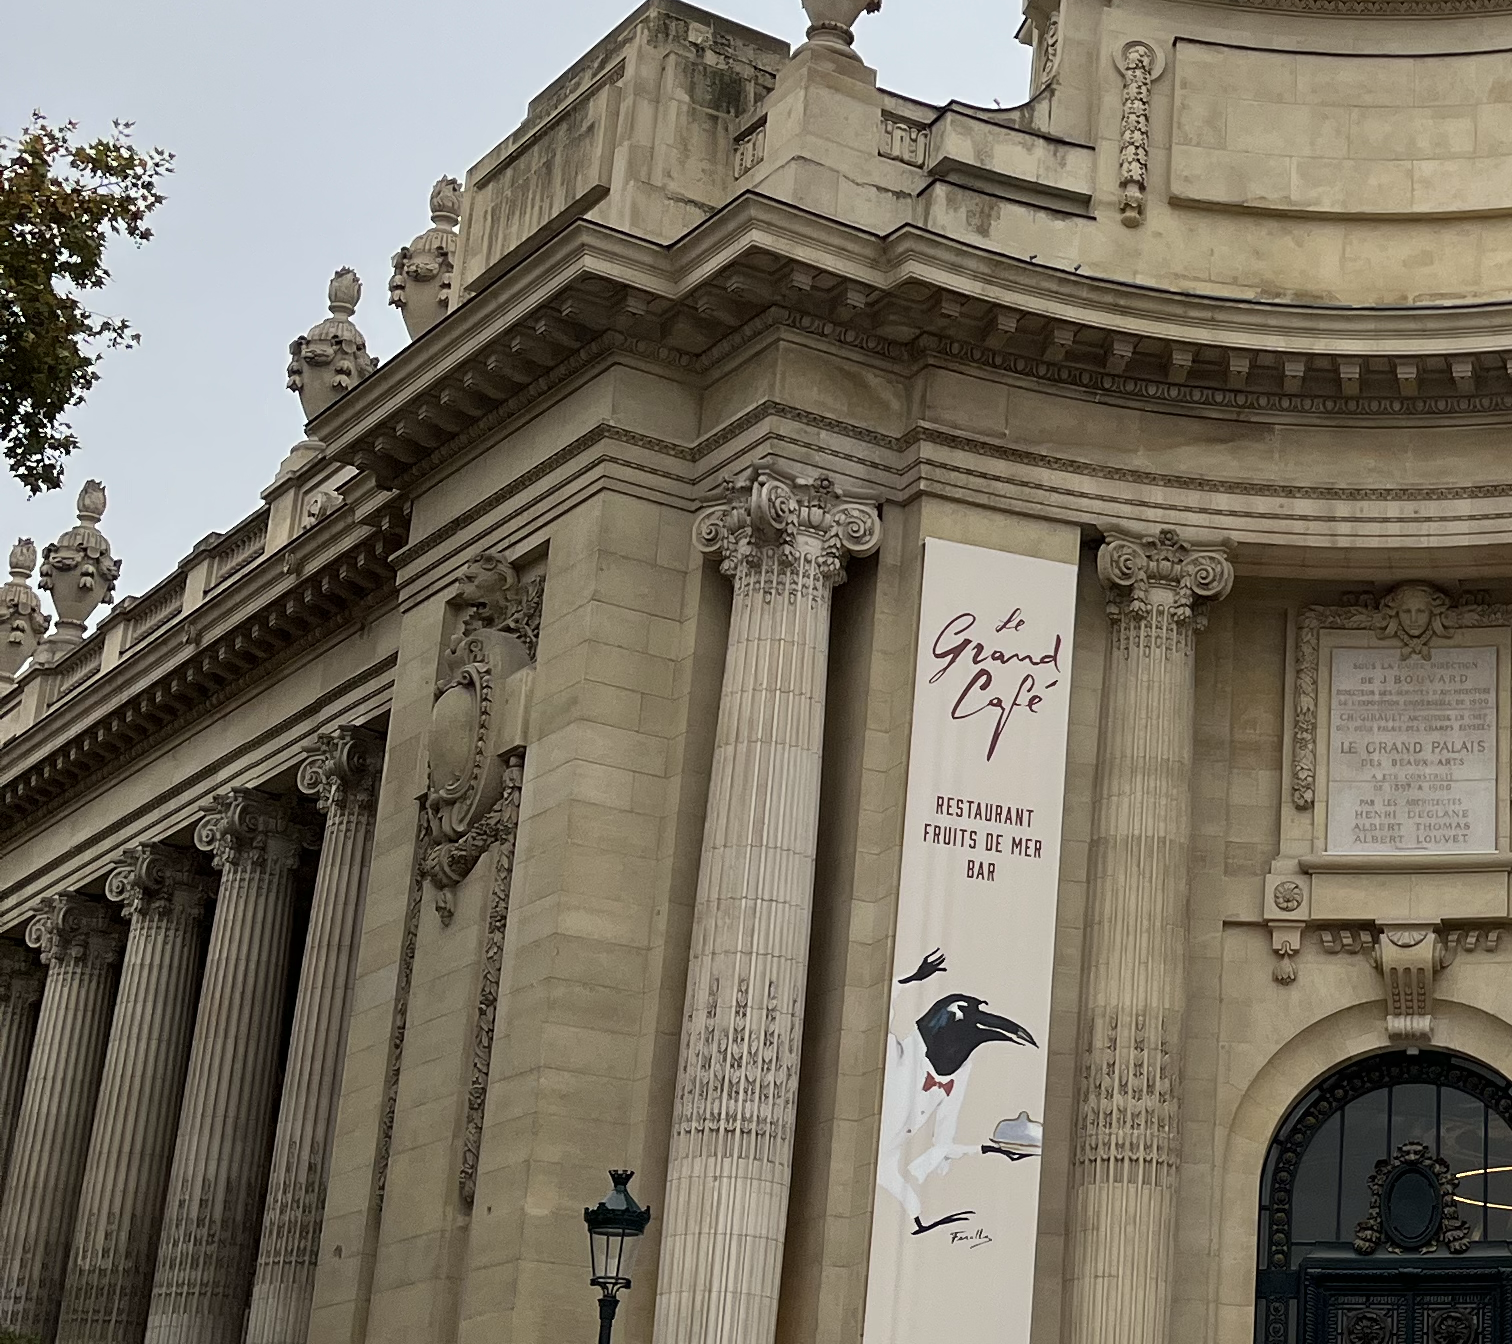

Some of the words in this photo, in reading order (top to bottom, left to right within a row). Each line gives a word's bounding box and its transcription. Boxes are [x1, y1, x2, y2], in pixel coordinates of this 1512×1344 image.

[995, 608, 1025, 633] Le
[928, 613, 1062, 684] Grand
[1394, 674, 1468, 685] BOUVARD
[951, 668, 1059, 762] Café
[1340, 741, 1358, 754] LE
[1365, 741, 1423, 754] GRAND
[1431, 740, 1486, 754] PALAIS
[1361, 758, 1382, 767] DES
[1428, 783, 1452, 792] 1900
[1382, 798, 1397, 806] LES
[1405, 798, 1463, 806] ARCHITECTES
[936, 795, 1034, 828] RESTAURANT
[1354, 809, 1397, 819] HENRI
[1407, 809, 1470, 819] DEGLANE
[1352, 822, 1403, 832] ALBERT
[1415, 822, 1471, 832] THOMAS
[923, 823, 977, 849] FRUITS
[985, 832, 1003, 853] DE
[1011, 836, 1042, 859] MER
[1352, 835, 1404, 844] ALBERT
[1416, 834, 1469, 844] LOUVET
[966, 859, 996, 882] BAR
